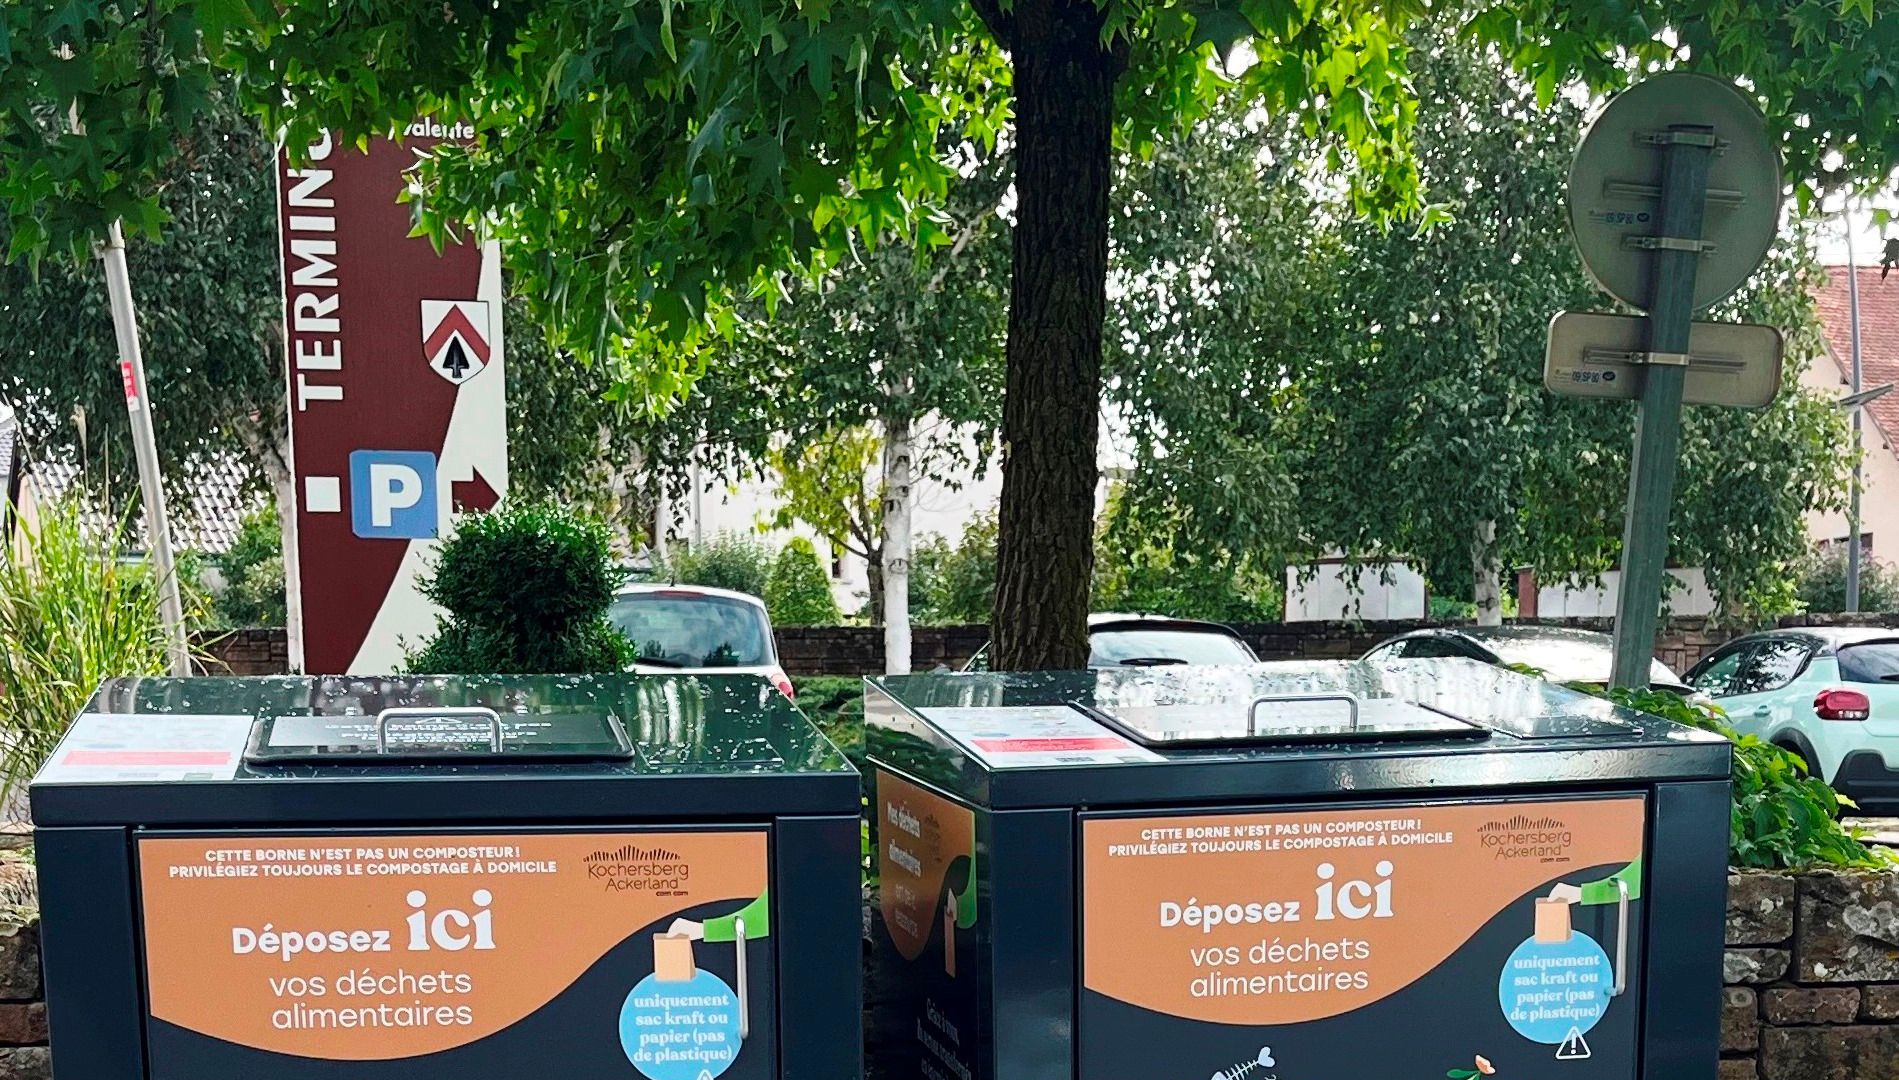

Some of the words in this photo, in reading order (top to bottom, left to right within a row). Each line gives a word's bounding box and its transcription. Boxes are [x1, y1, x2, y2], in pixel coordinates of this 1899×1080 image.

[370, 464, 422, 527] P
[1141, 828, 1182, 840] CETTE
[1186, 826, 1230, 838] BORNE
[1234, 824, 1271, 836] N'EST
[1275, 823, 1300, 835] PAS
[1303, 822, 1322, 834] UN
[1481, 831, 1572, 847] Kochersberg
[1108, 840, 1187, 856] PRIVILÉGIEZ
[1190, 839, 1261, 853] TOUJOURS
[1265, 839, 1280, 850] LE
[1283, 835, 1374, 849] COMPOSTAGE
[1377, 831, 1387, 845] À
[1391, 831, 1453, 845] DOMICILE
[1495, 844, 1562, 860] Ackerland
[205, 849, 251, 861] CETTE
[255, 848, 306, 861] BORNE
[309, 848, 352, 860] N'EST
[356, 847, 384, 859] PAS
[388, 847, 408, 859] UN
[169, 861, 258, 877] PRIVILÉGIEZ
[261, 863, 342, 876] TOUJOURS
[346, 863, 363, 875] LE
[366, 862, 469, 875] COMPOSTAGE
[473, 862, 483, 873] À
[487, 861, 556, 873] DOMICILE
[588, 862, 689, 880] Kochersberg
[605, 878, 679, 892] Ackerland
[1160, 897, 1300, 933] Déposez
[1315, 860, 1394, 920] ici
[232, 923, 391, 962] Déposez
[405, 889, 497, 952] ici
[1190, 946, 1239, 966] vos
[1248, 937, 1369, 964] déchets
[1514, 954, 1600, 969] uniquement
[269, 976, 326, 996] vos
[335, 967, 471, 995] déchets
[1190, 967, 1368, 997] alimentaires
[634, 994, 729, 1009] uniquement
[272, 999, 472, 1029] alimentaires
[635, 1013, 662, 1025] sac
[665, 1007, 705, 1025] kraft
[708, 1013, 728, 1024] ou
[640, 1029, 688, 1044] papier
[692, 1029, 725, 1044] (pas
[633, 1047, 652, 1062] de
[654, 1046, 732, 1064] plastique)
